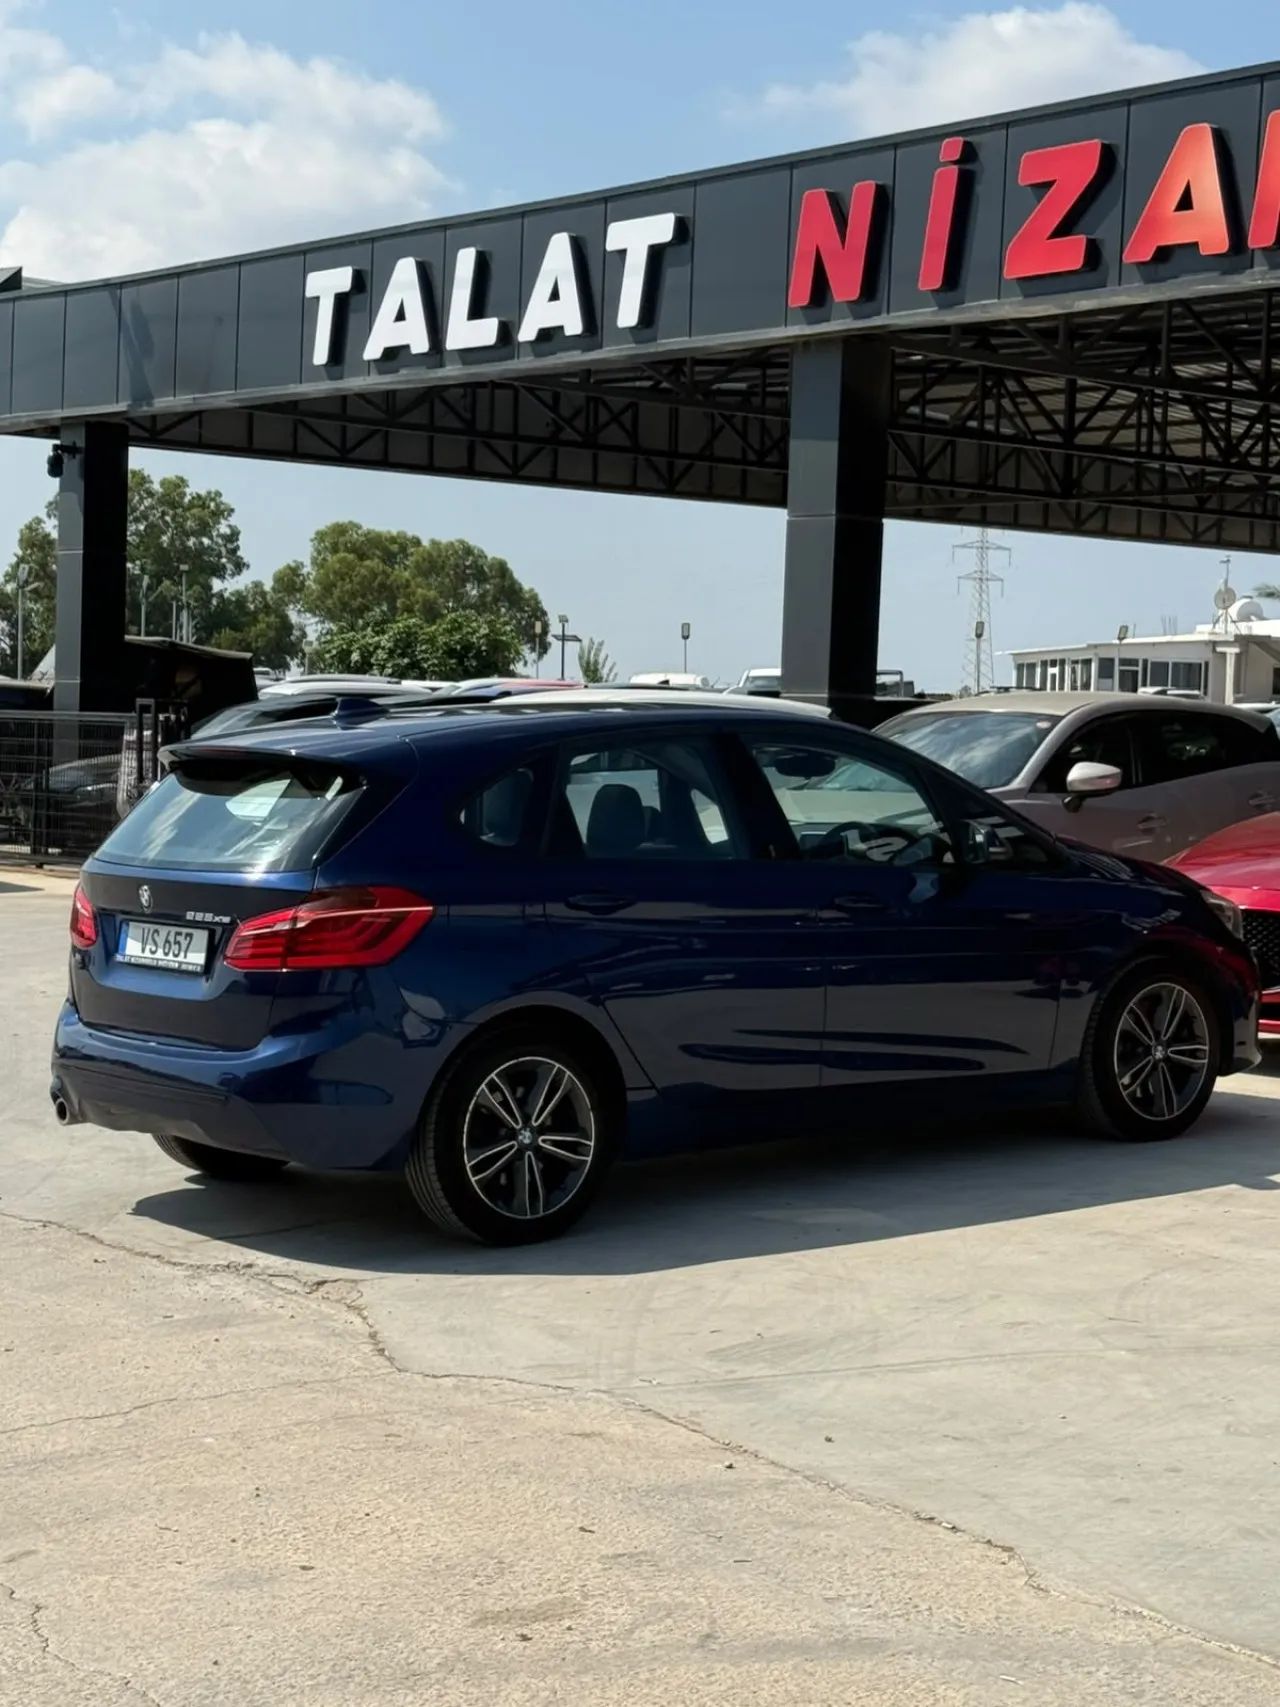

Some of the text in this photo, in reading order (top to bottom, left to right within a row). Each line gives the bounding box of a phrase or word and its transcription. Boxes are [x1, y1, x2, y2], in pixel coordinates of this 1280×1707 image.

[305, 212, 676, 367] TALAT
[141, 927, 194, 959] VS 657
